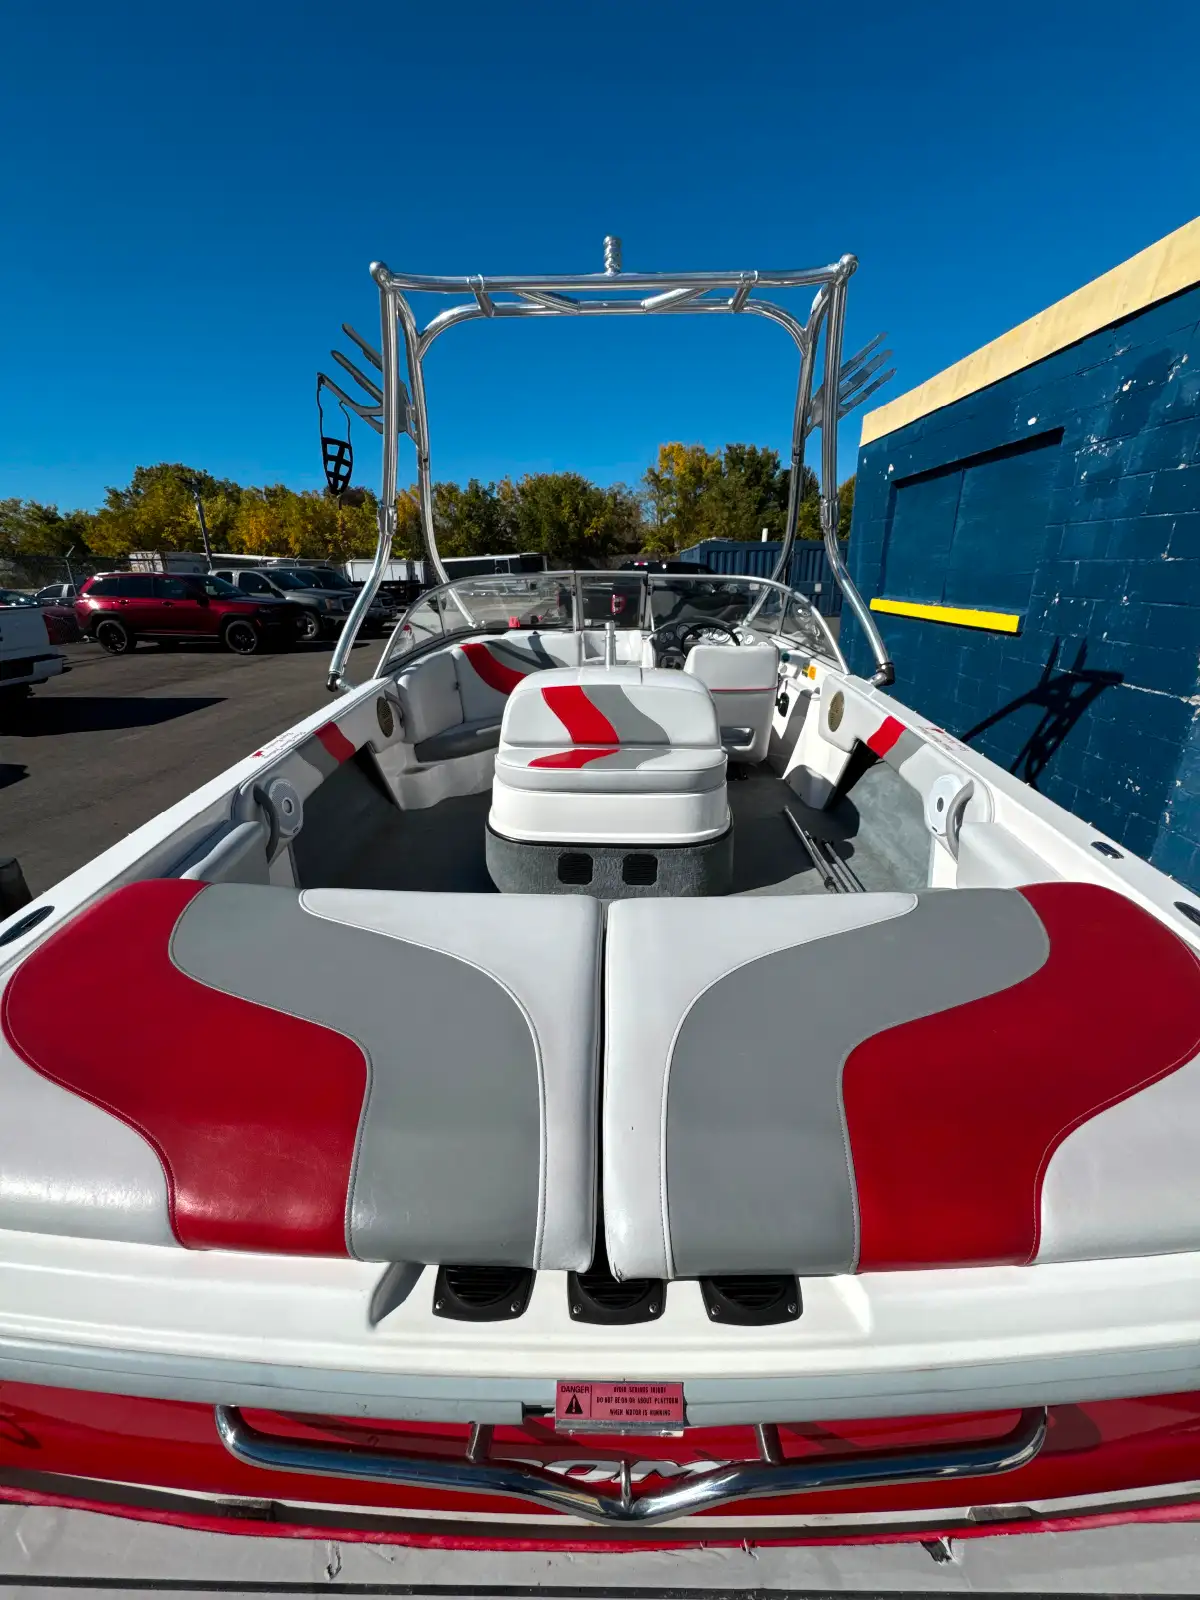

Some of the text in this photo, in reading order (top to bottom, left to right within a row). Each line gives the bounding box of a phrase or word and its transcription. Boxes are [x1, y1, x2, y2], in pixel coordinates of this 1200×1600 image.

[560, 1385, 590, 1394] DANGER
[596, 1396, 604, 1404] DO
[604, 1396, 613, 1404] NOT
[614, 1396, 621, 1404] BE
[654, 1397, 679, 1405] PLATFORM
[609, 1408, 624, 1416] WHEN
[625, 1408, 641, 1416] MOTOR
[649, 1409, 671, 1417] RUNNING
